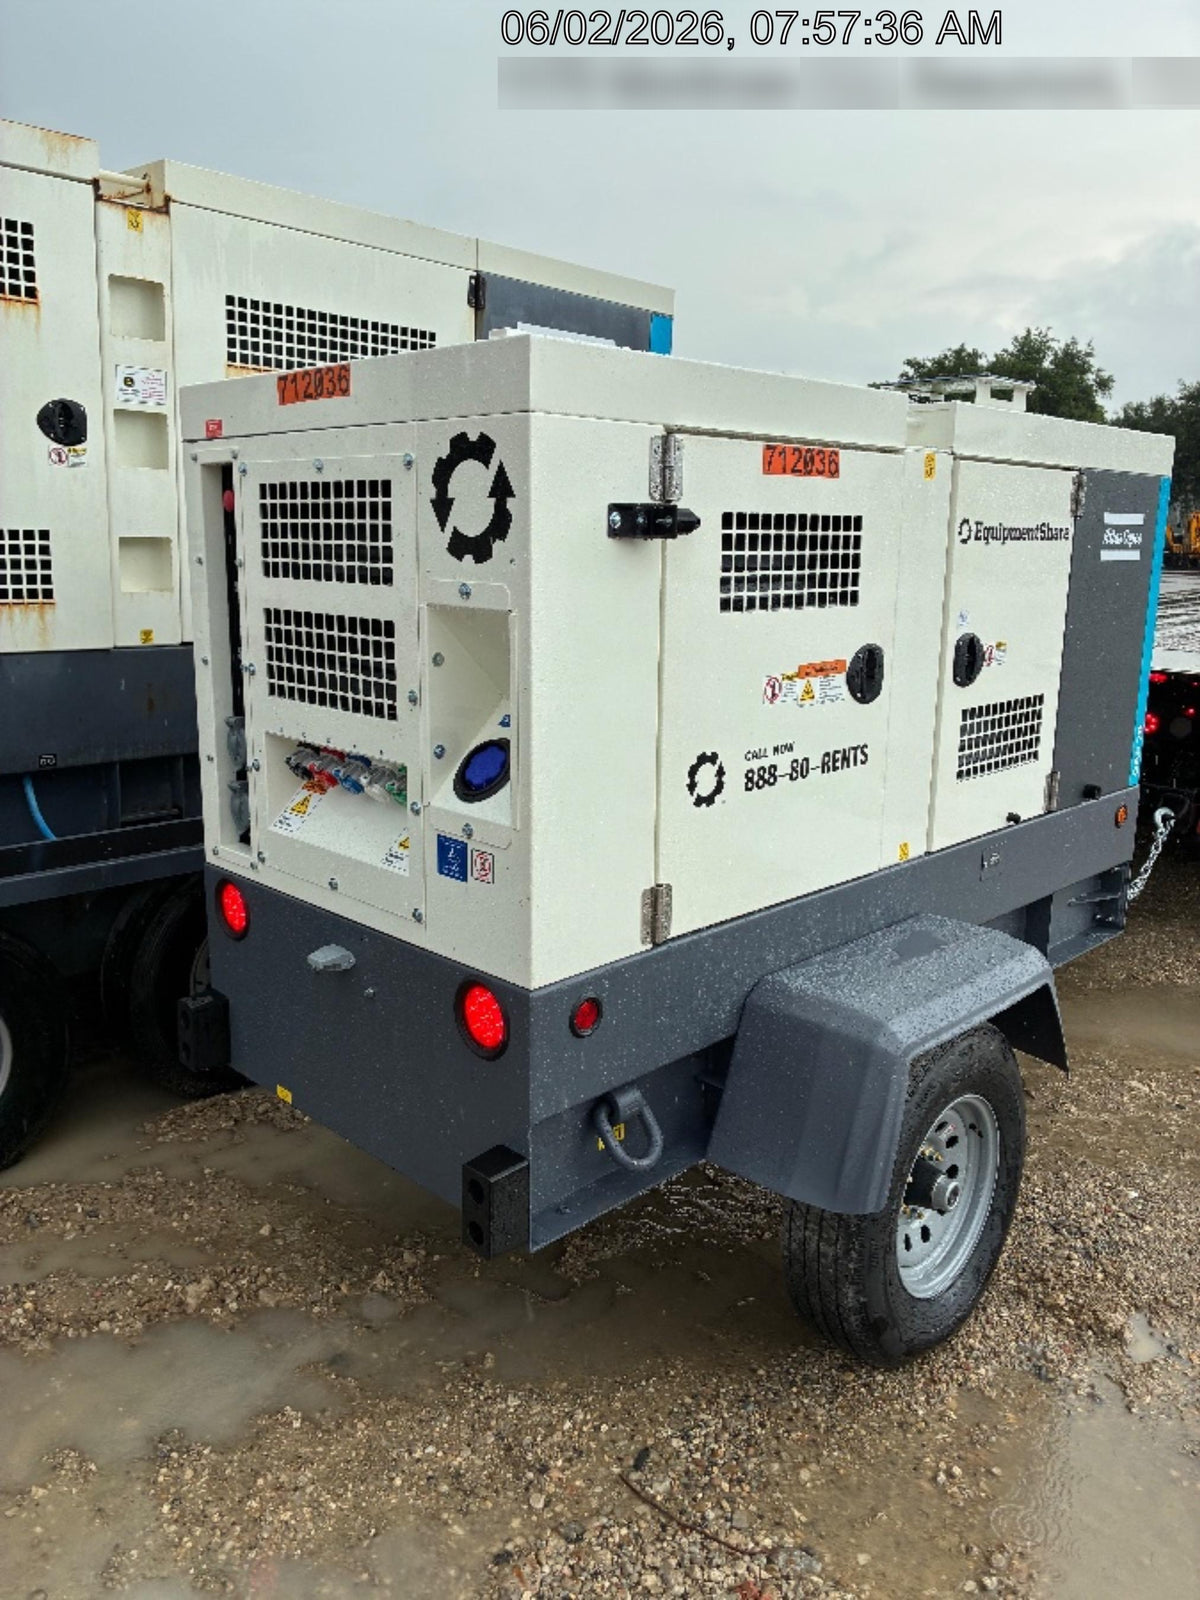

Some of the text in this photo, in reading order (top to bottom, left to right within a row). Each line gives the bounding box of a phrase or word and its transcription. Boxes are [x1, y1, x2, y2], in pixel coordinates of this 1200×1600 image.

[277, 364, 350, 406] 712036
[764, 444, 839, 477] 712036
[974, 521, 1070, 546] EquipmentShare
[744, 741, 796, 762] CALL NOW
